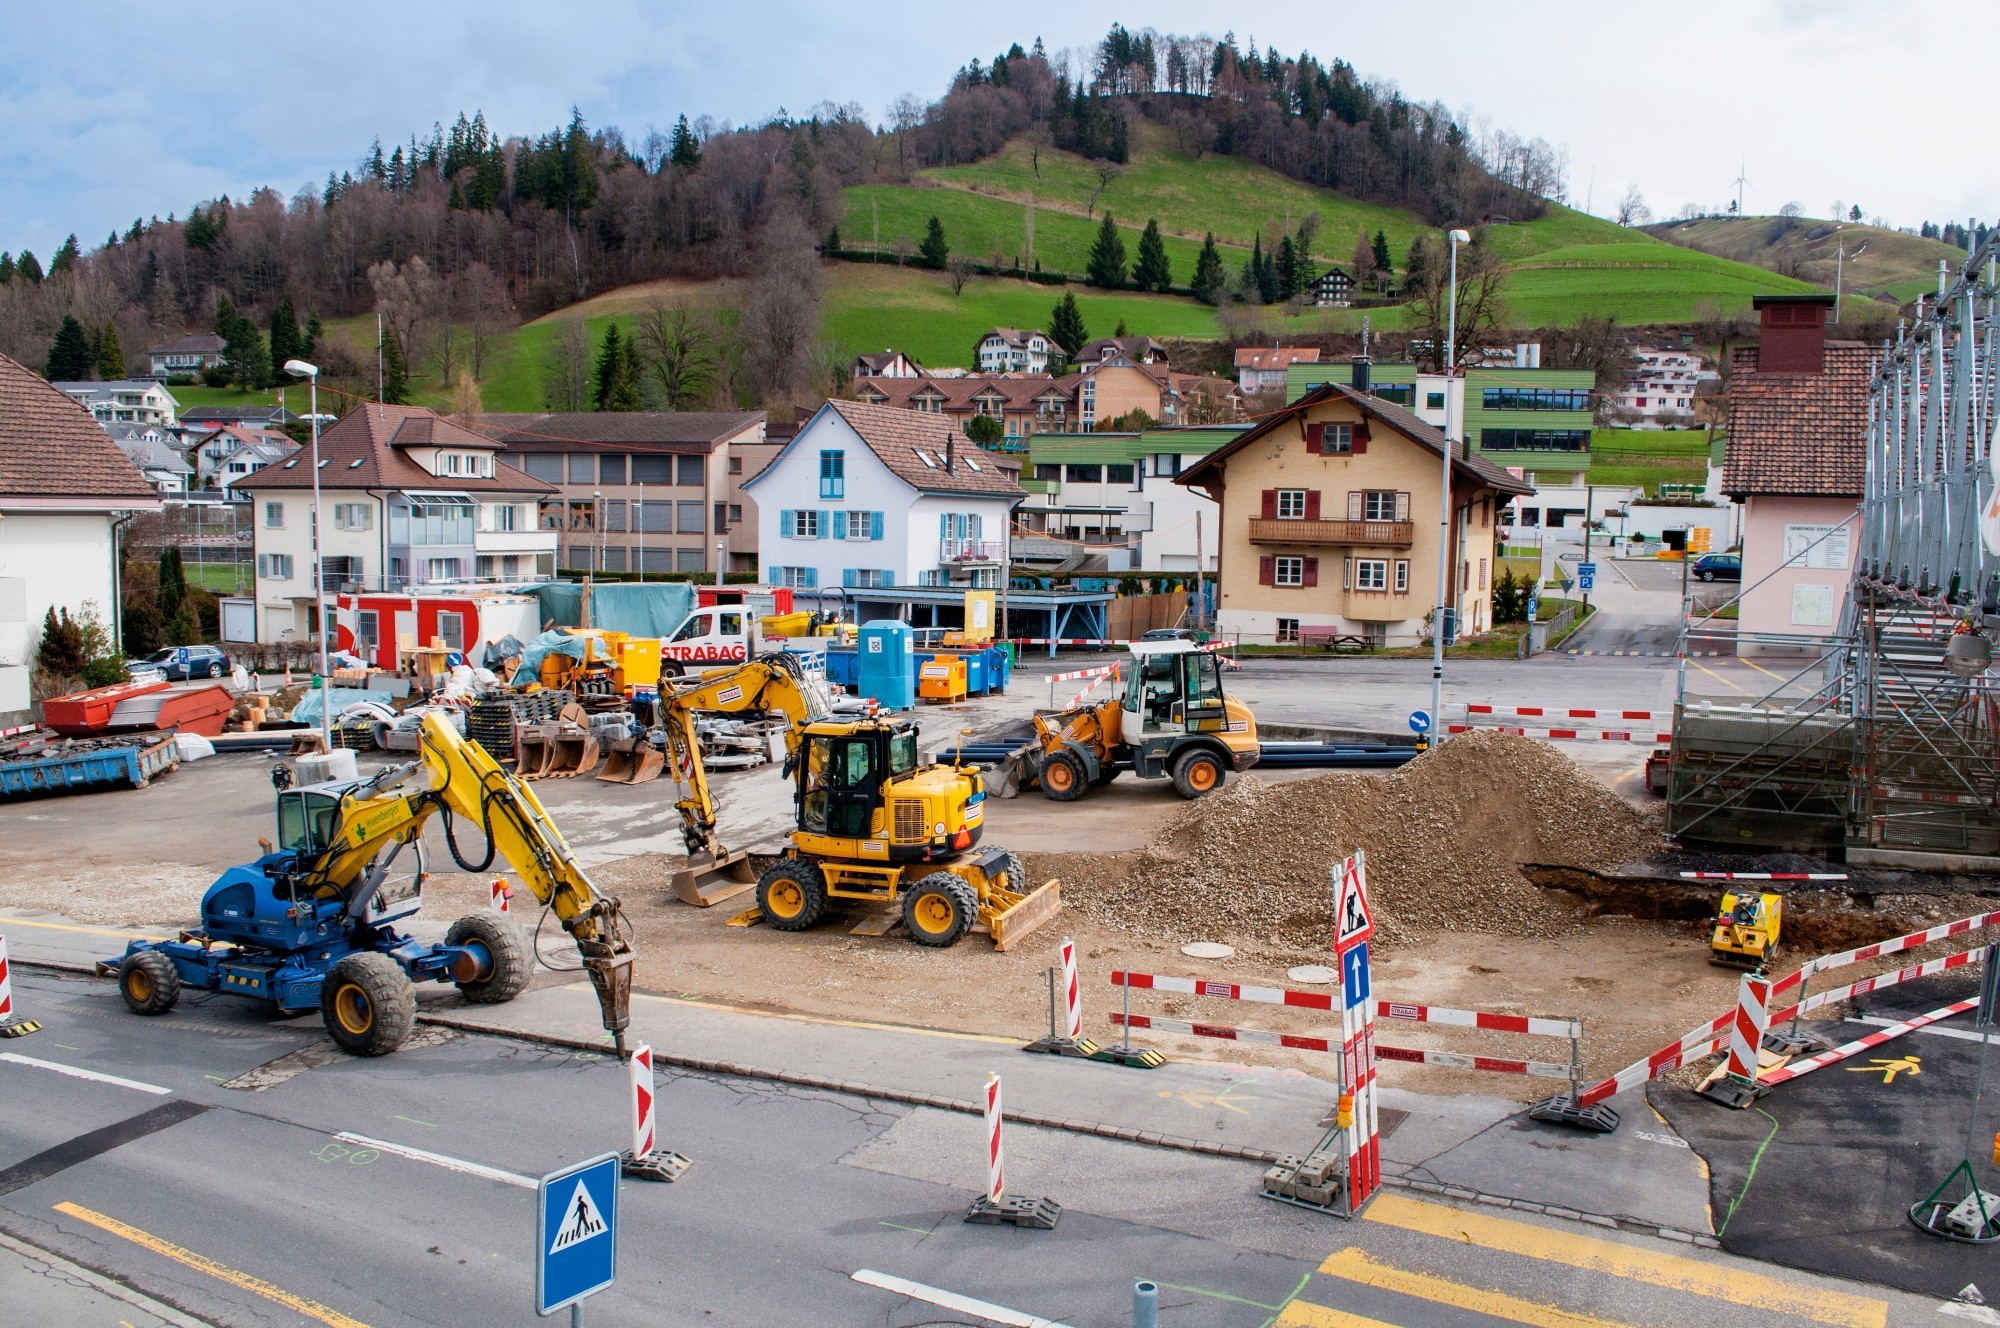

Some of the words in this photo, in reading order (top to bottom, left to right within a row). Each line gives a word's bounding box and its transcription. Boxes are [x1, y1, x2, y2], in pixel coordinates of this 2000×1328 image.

[661, 645, 747, 660] STRABAG
[720, 690, 741, 700] STRABAG
[365, 804, 399, 828] leuenberger
[1207, 986, 1230, 994] STRABAG
[1391, 1007, 1417, 1015] STRABAG
[1376, 1048, 1423, 1061] STRABAG
